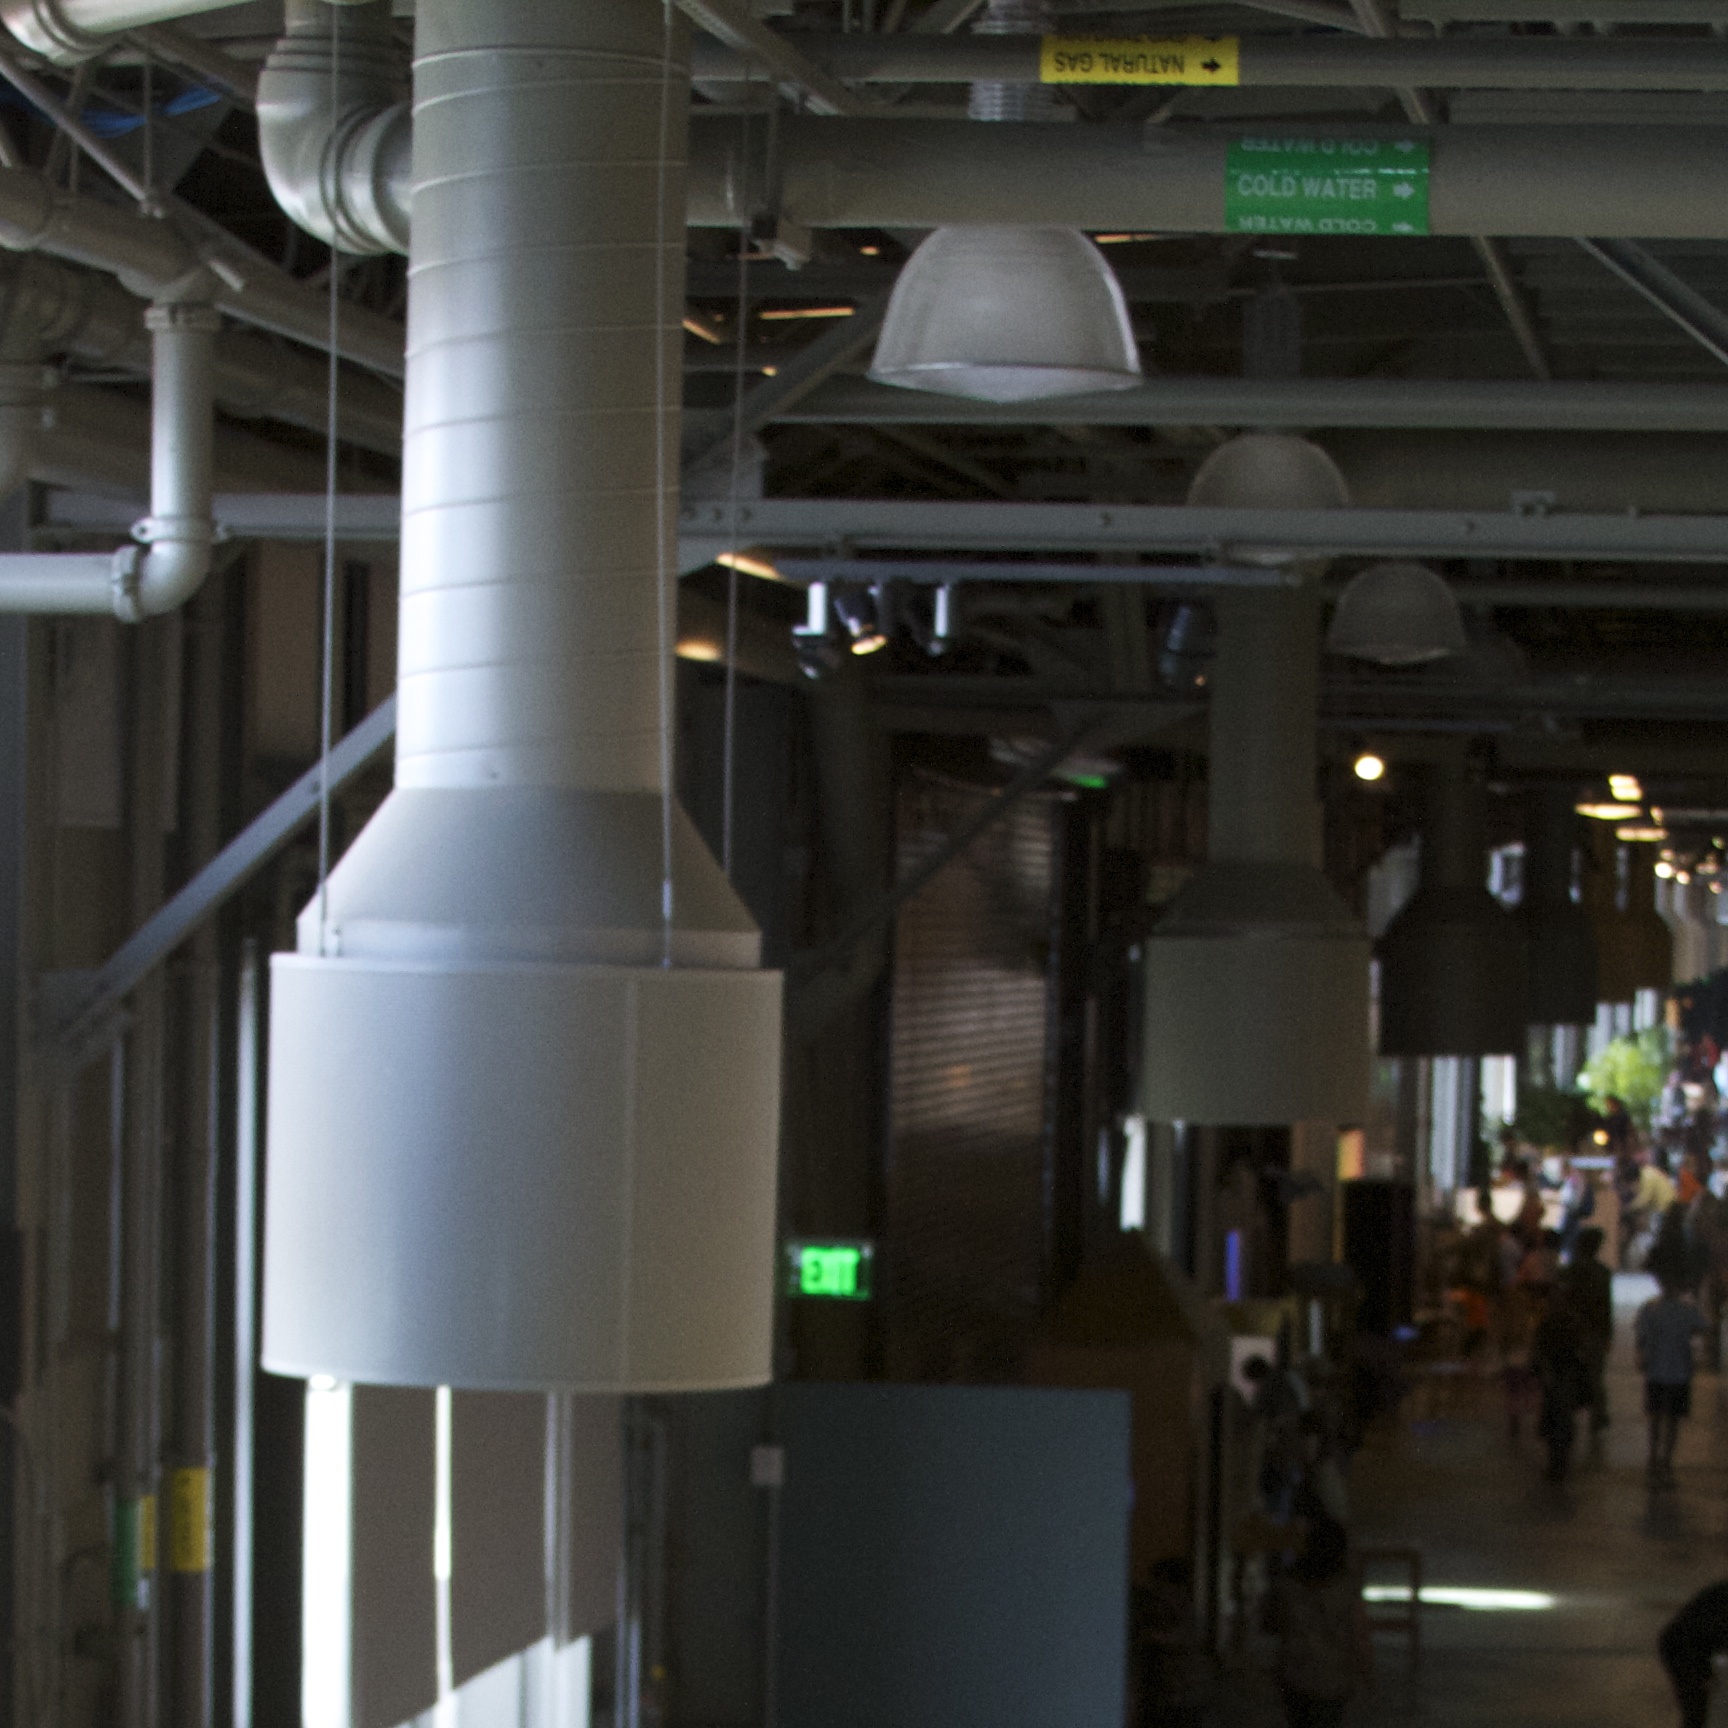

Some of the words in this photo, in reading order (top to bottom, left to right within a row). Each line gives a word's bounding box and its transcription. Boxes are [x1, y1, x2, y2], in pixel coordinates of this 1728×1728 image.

[1053, 51, 1094, 73] GAS
[1099, 53, 1185, 74] NATURAL
[1237, 173, 1297, 198] COLD
[1302, 177, 1377, 201] WATER
